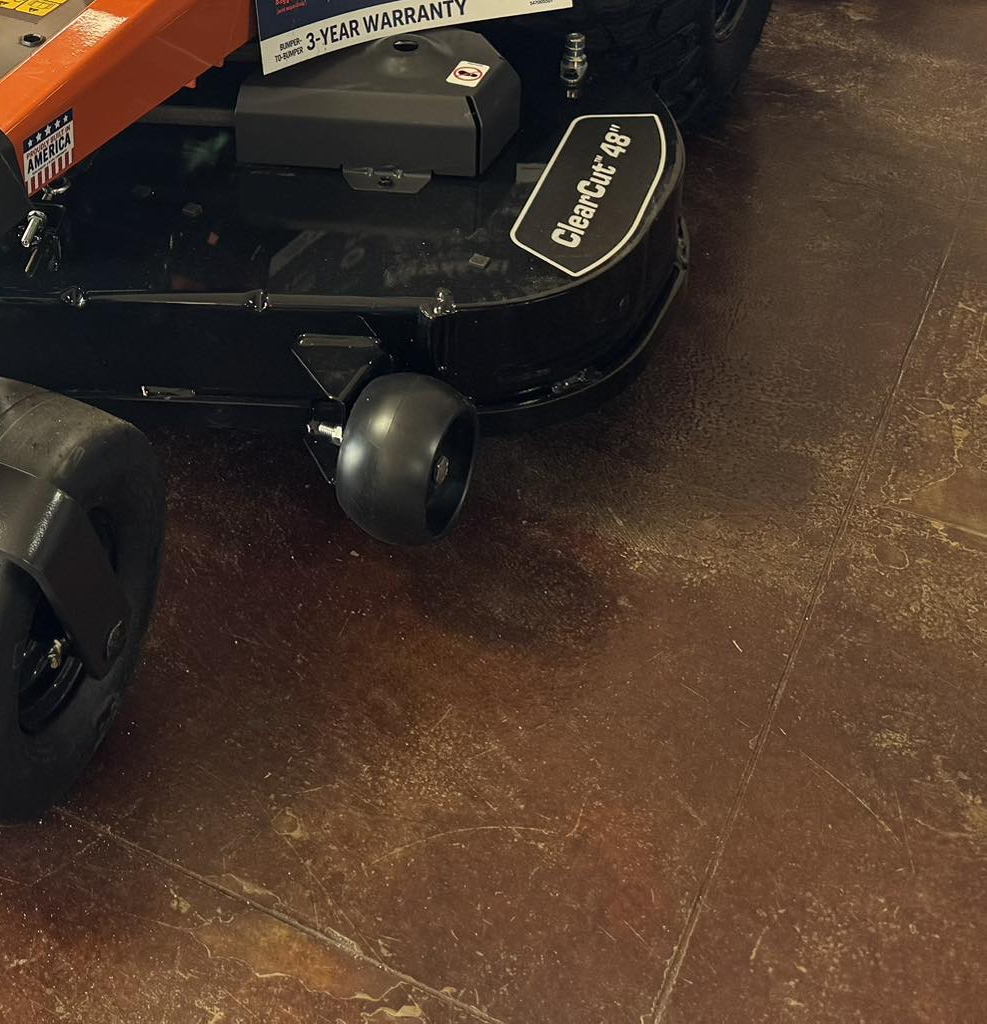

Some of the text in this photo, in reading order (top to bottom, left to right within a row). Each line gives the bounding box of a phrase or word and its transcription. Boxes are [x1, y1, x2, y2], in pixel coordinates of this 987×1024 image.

[279, 37, 302, 51] BUMPER-
[305, 19, 361, 51] 3-YEAR
[275, 46, 304, 63] TO-BUMPER
[26, 140, 49, 159] PROUDLY
[50, 128, 64, 143] BUILT
[27, 133, 71, 174] AMERICA
[600, 124, 631, 158] 48"
